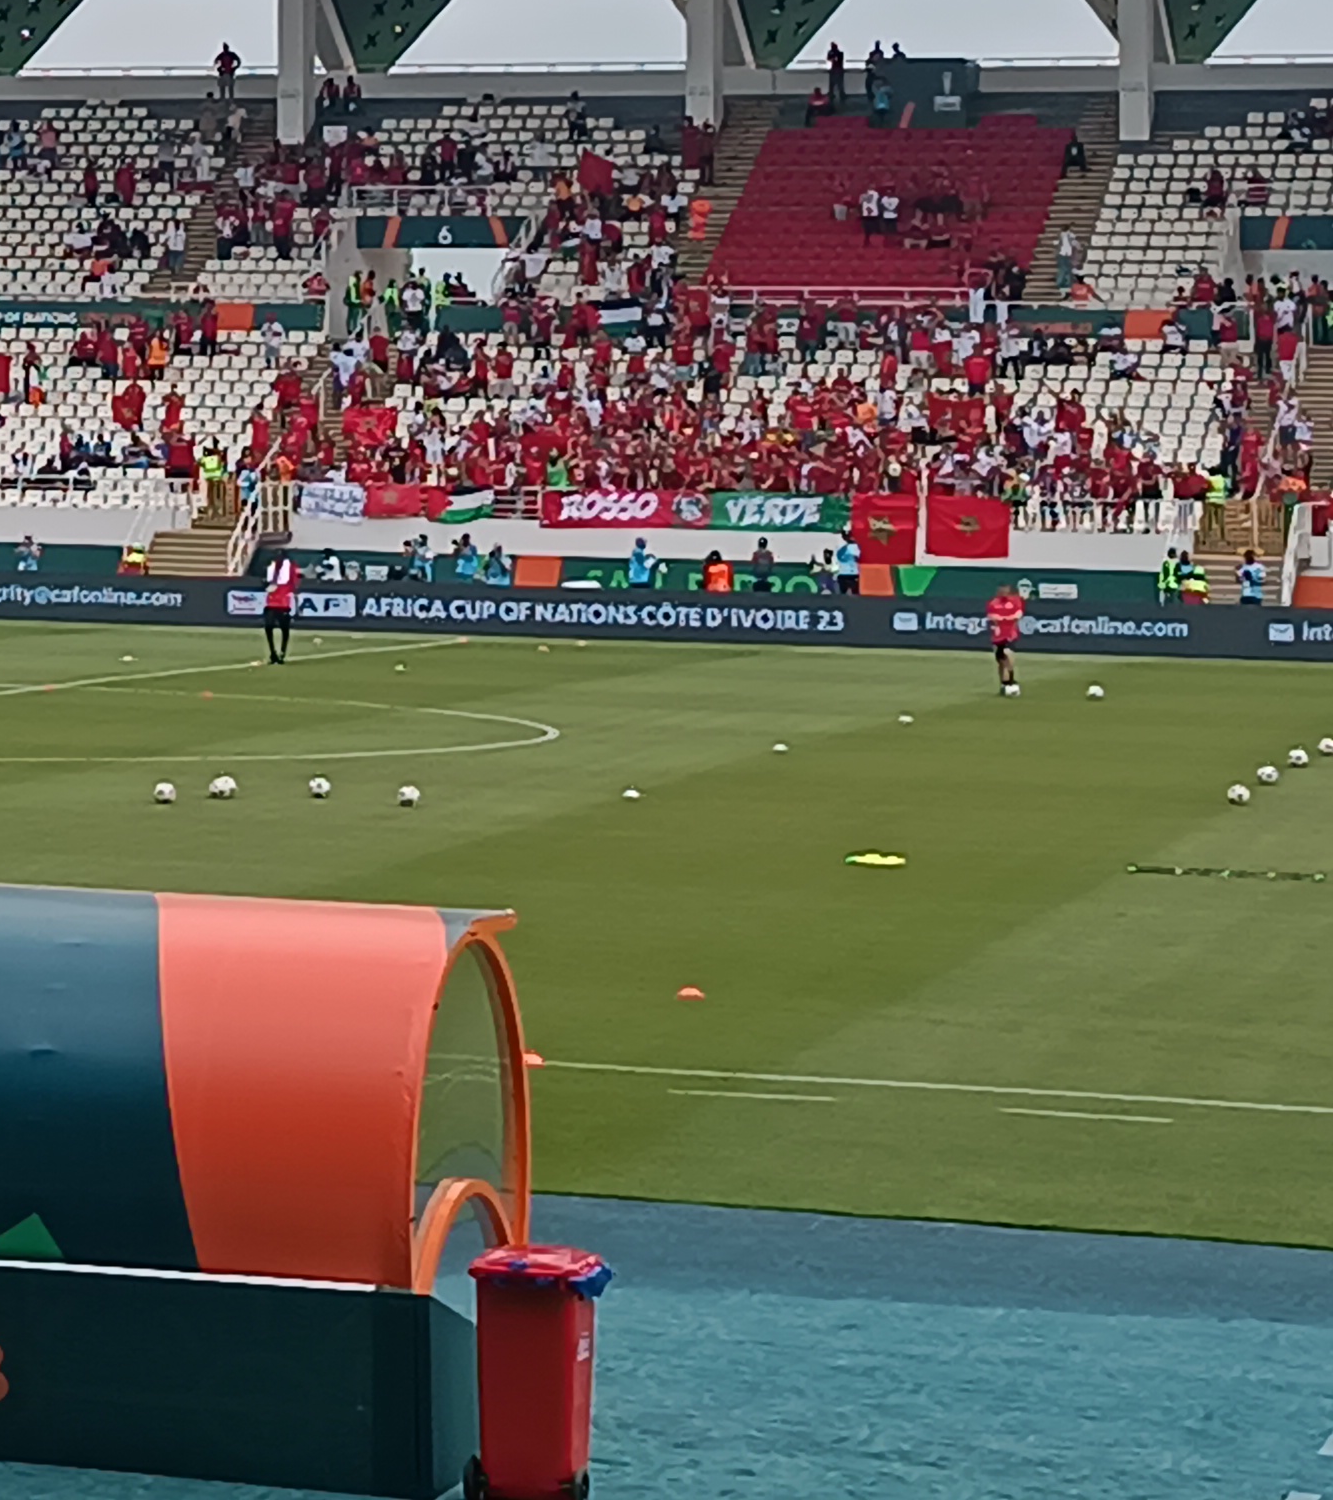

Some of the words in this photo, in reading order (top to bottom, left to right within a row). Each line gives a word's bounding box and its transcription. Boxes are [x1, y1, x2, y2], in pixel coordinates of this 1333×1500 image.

[437, 225, 453, 245] 6
[559, 492, 658, 521] ROSSO
[725, 497, 824, 526] VERDE
[362, 596, 448, 620] AFRICA
[449, 599, 496, 621] CUP
[498, 601, 532, 623] OF
[534, 603, 637, 625] NATIONS
[640, 601, 702, 627] CÔTE
[815, 610, 845, 632] 23
